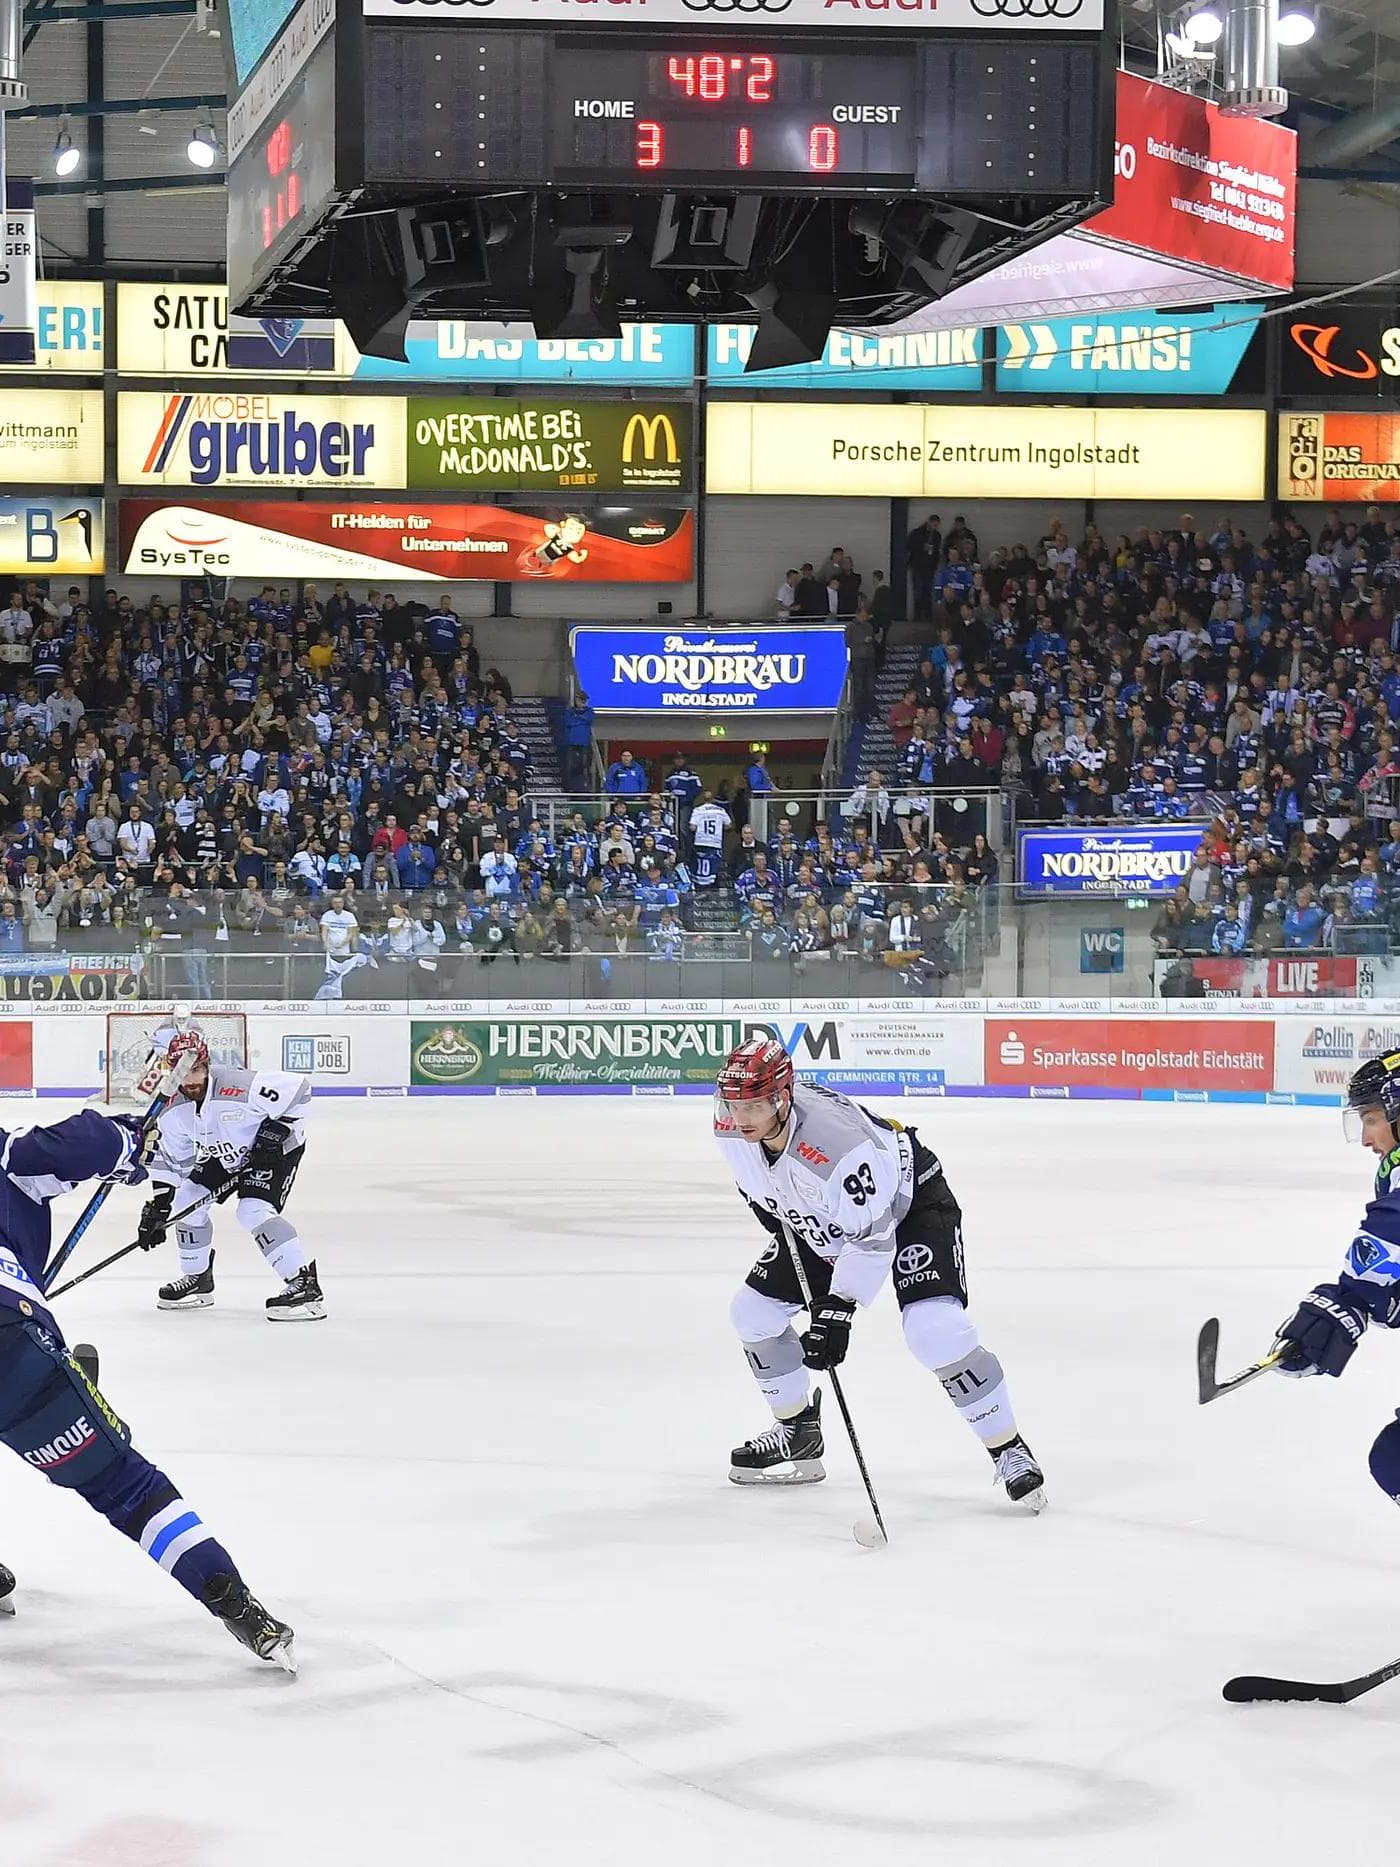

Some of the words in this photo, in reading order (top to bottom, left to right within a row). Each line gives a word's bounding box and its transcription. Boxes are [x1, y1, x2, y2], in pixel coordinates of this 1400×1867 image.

[574, 101, 635, 118] HOME
[833, 105, 901, 123] GUEST
[637, 123, 662, 167] 3
[738, 127, 751, 166] 1
[809, 127, 837, 168] 0
[1070, 325, 1191, 371] FANS!
[193, 396, 277, 420] MÖBEL
[189, 411, 375, 484] gruber
[832, 439, 921, 461] Porsche
[927, 440, 1021, 464] Zentrum
[1027, 441, 1141, 469] Ingolstadt
[1323, 447, 1360, 462] DAS
[1324, 464, 1400, 480] ORIGINA
[332, 513, 404, 529] IT-Helden
[407, 515, 432, 529] für
[402, 537, 508, 553] Unternehmen
[140, 549, 230, 566] SysTec
[612, 655, 805, 690] NORDBRÄU
[662, 693, 757, 706] INGOLSTADT
[703, 820, 716, 834] 15
[1042, 850, 1190, 881] NORDBRÄU
[1083, 933, 1121, 952] WC
[1276, 962, 1319, 993] LIVE
[35, 1004, 58, 1012] Audi
[142, 1004, 165, 1012] Audi
[195, 1004, 217, 1012] Audi
[263, 1004, 286, 1012] Audi
[345, 1004, 367, 1012] Audi
[426, 1004, 448, 1012] Audi
[507, 1003, 529, 1011] Audi
[584, 1003, 607, 1011] Audi
[661, 1003, 683, 1011] Audi
[733, 1003, 755, 1011] Audi
[488, 1023, 732, 1060] HERRNBRÄU
[744, 1021, 841, 1060] DVM
[1314, 1026, 1354, 1048] Pollin
[288, 1040, 312, 1053] KEIN
[317, 1041, 343, 1053] OHNE
[866, 1047, 931, 1057] www.dvm.de
[288, 1054, 311, 1068] FAN
[317, 1053, 346, 1069] JOB.
[1032, 1048, 1116, 1068] Sparkasse
[1121, 1049, 1200, 1072] Ingolstadt
[1203, 1050, 1265, 1070] Eichstätt
[534, 1062, 682, 1081] Weißbier-Spezialitäten
[827, 1072, 896, 1083] GEMMINGER
[899, 1072, 924, 1083] STR.
[926, 1072, 939, 1083] 14
[218, 1087, 245, 1098] HIT
[259, 1085, 280, 1103] 5
[797, 1141, 830, 1166] HIT
[243, 1179, 271, 1190] TOYOTA
[843, 1162, 877, 1207] 93
[898, 1270, 941, 1291] TOYOTA
[24, 1416, 96, 1466] CINQUE
